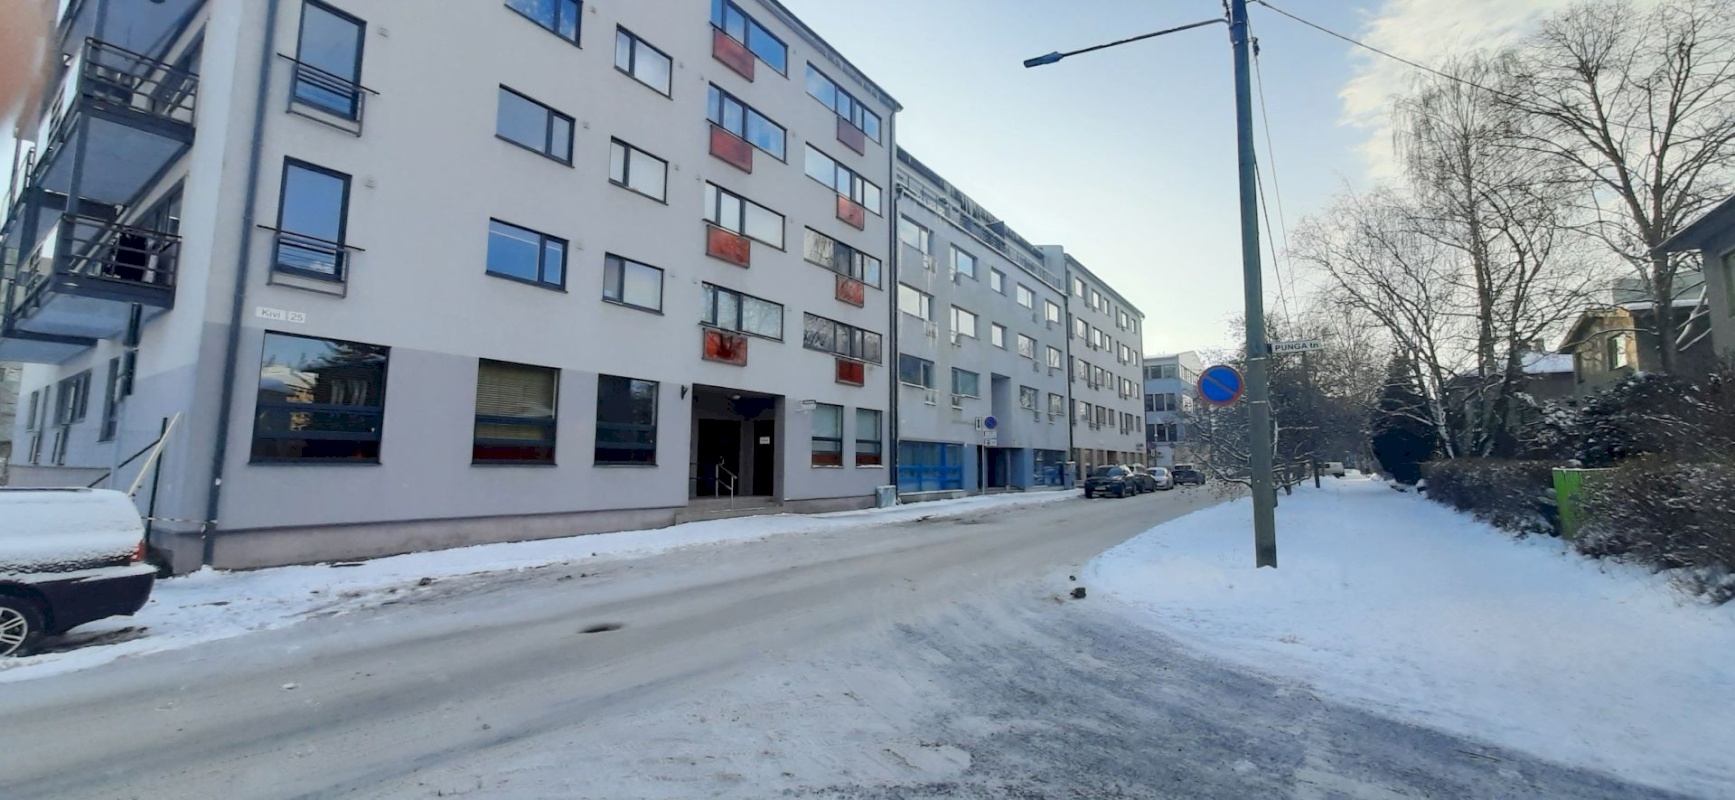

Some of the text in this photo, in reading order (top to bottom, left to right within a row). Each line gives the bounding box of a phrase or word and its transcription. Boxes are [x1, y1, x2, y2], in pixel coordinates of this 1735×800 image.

[261, 308, 303, 321] Kivi 25
[1275, 343, 1308, 351] PUNGA
